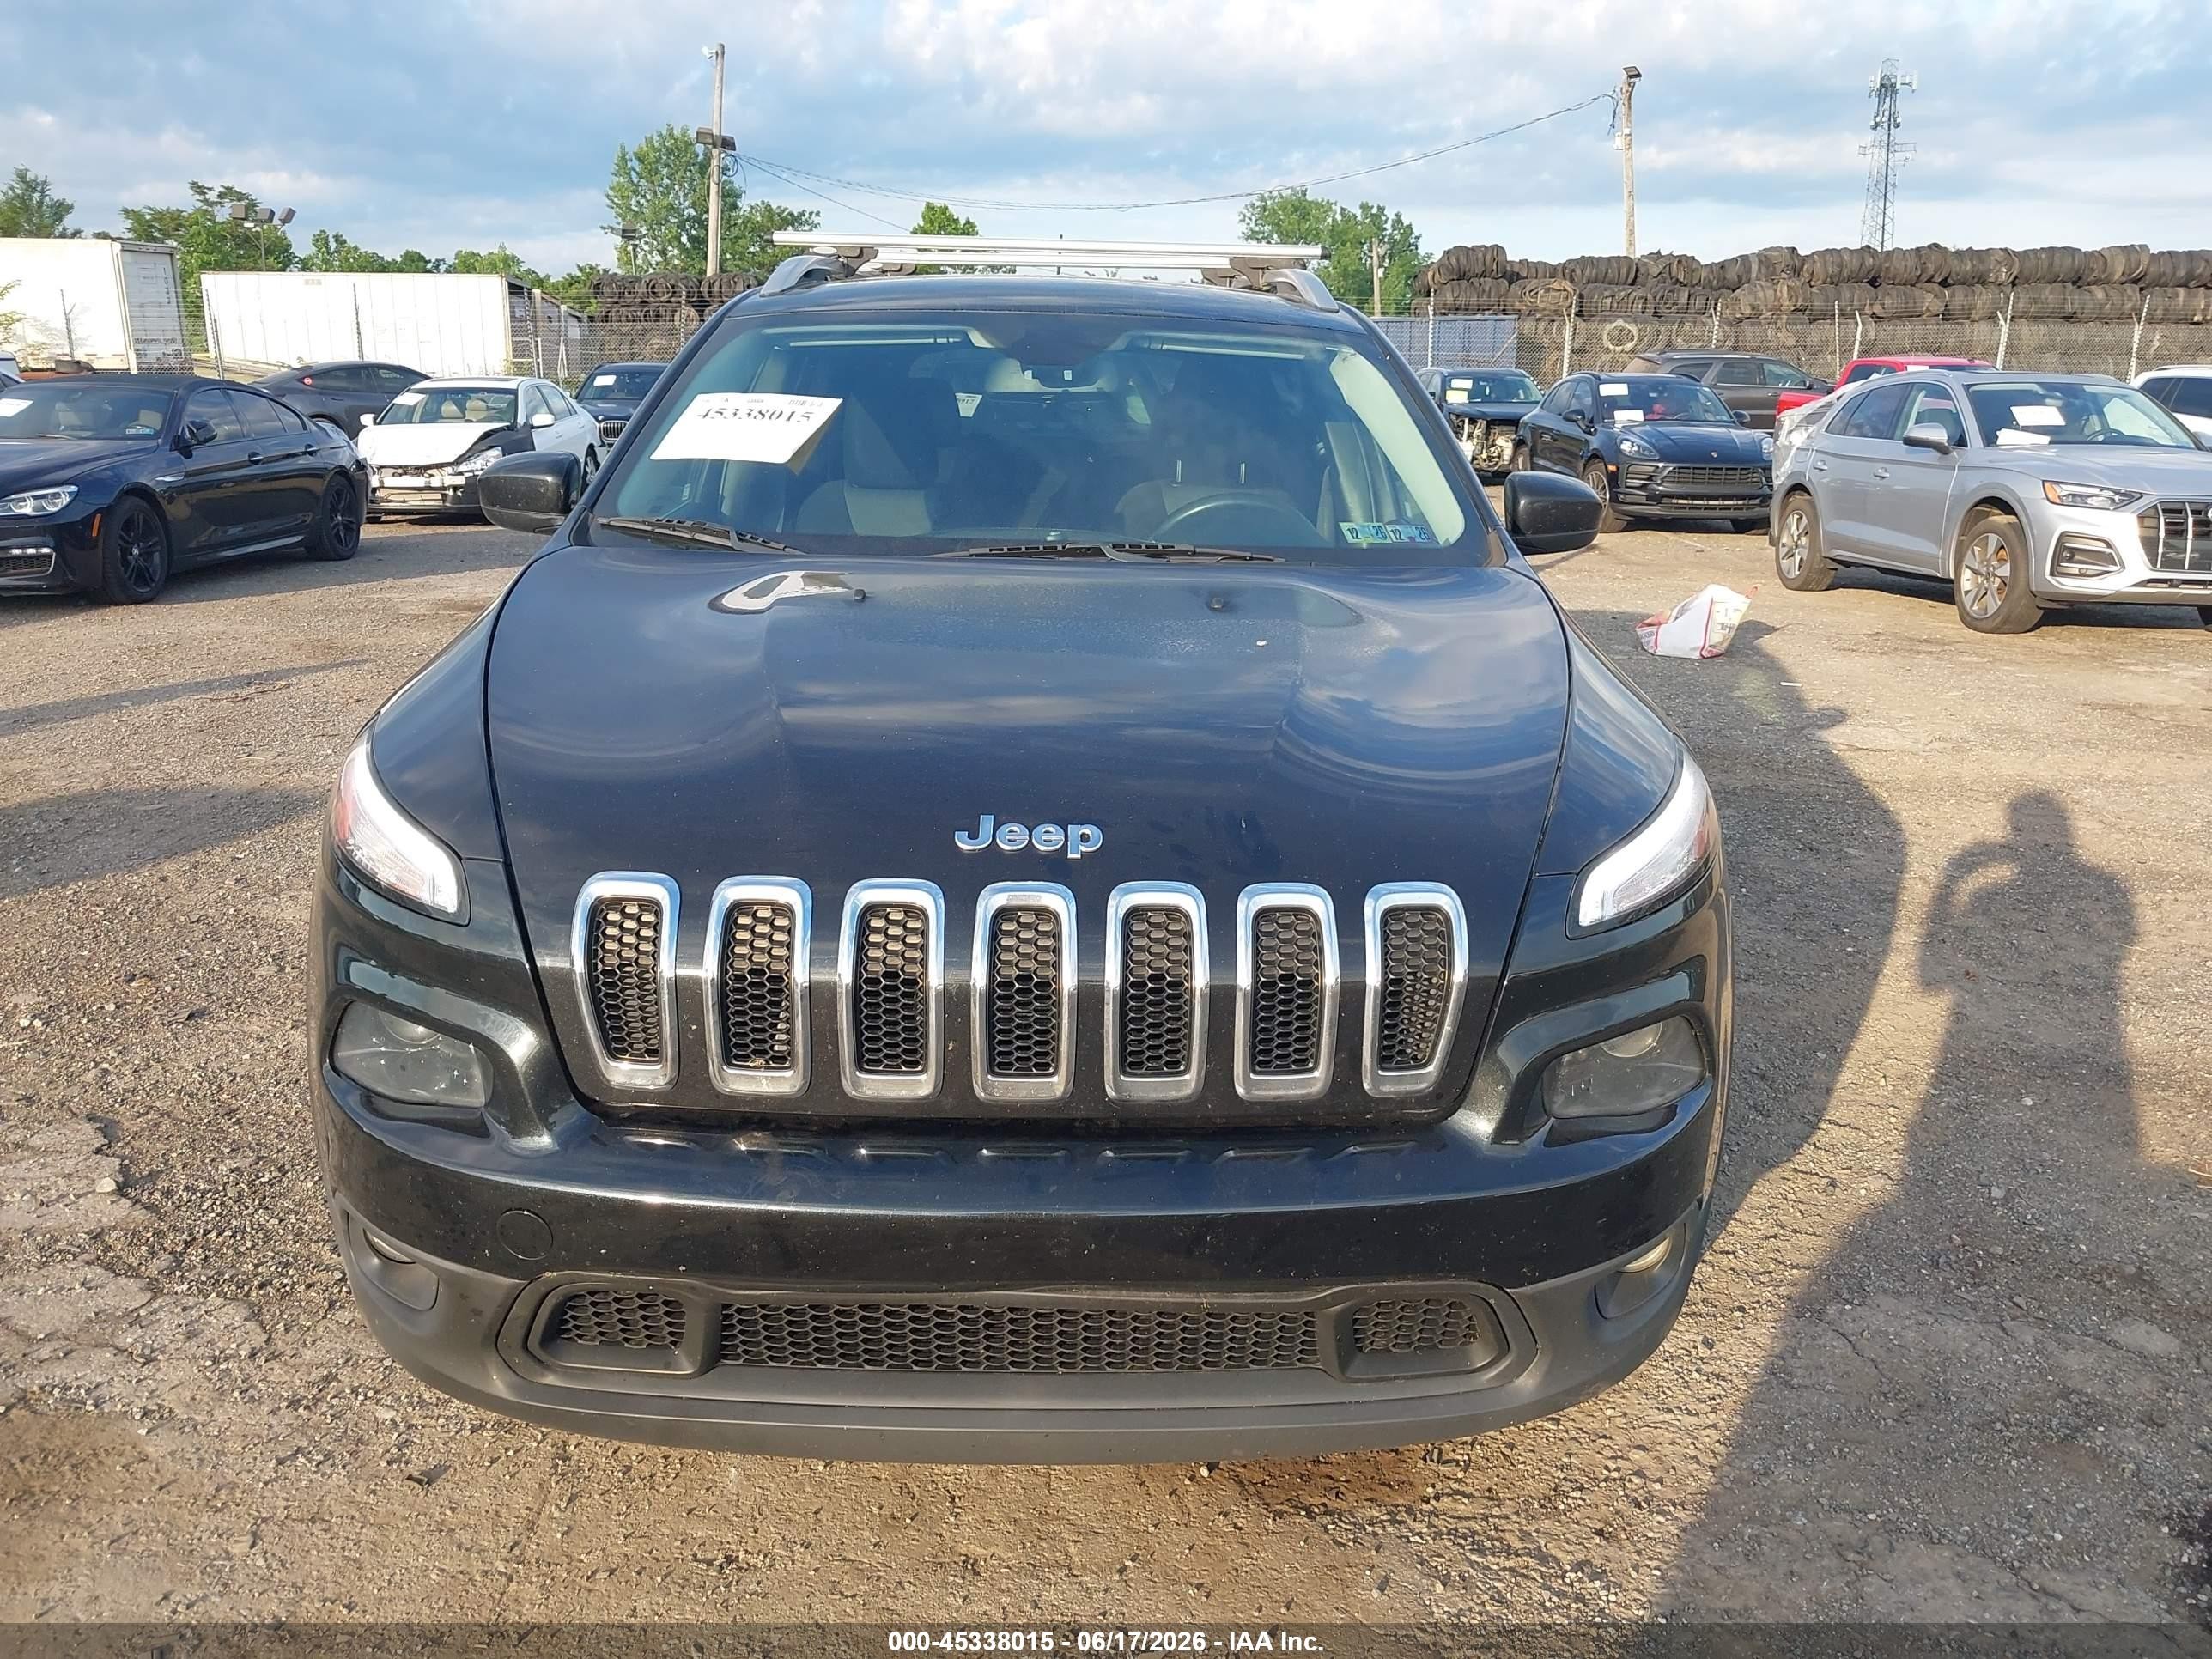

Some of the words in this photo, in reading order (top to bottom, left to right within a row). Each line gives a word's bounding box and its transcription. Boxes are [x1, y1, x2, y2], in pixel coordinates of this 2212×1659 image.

[696, 407, 817, 423] 45338015
[1346, 527, 1362, 540] 12
[1372, 525, 1388, 540] 26
[1390, 528, 1406, 541] 12
[1414, 526, 1431, 541] 26
[954, 814, 1103, 859] Jeep
